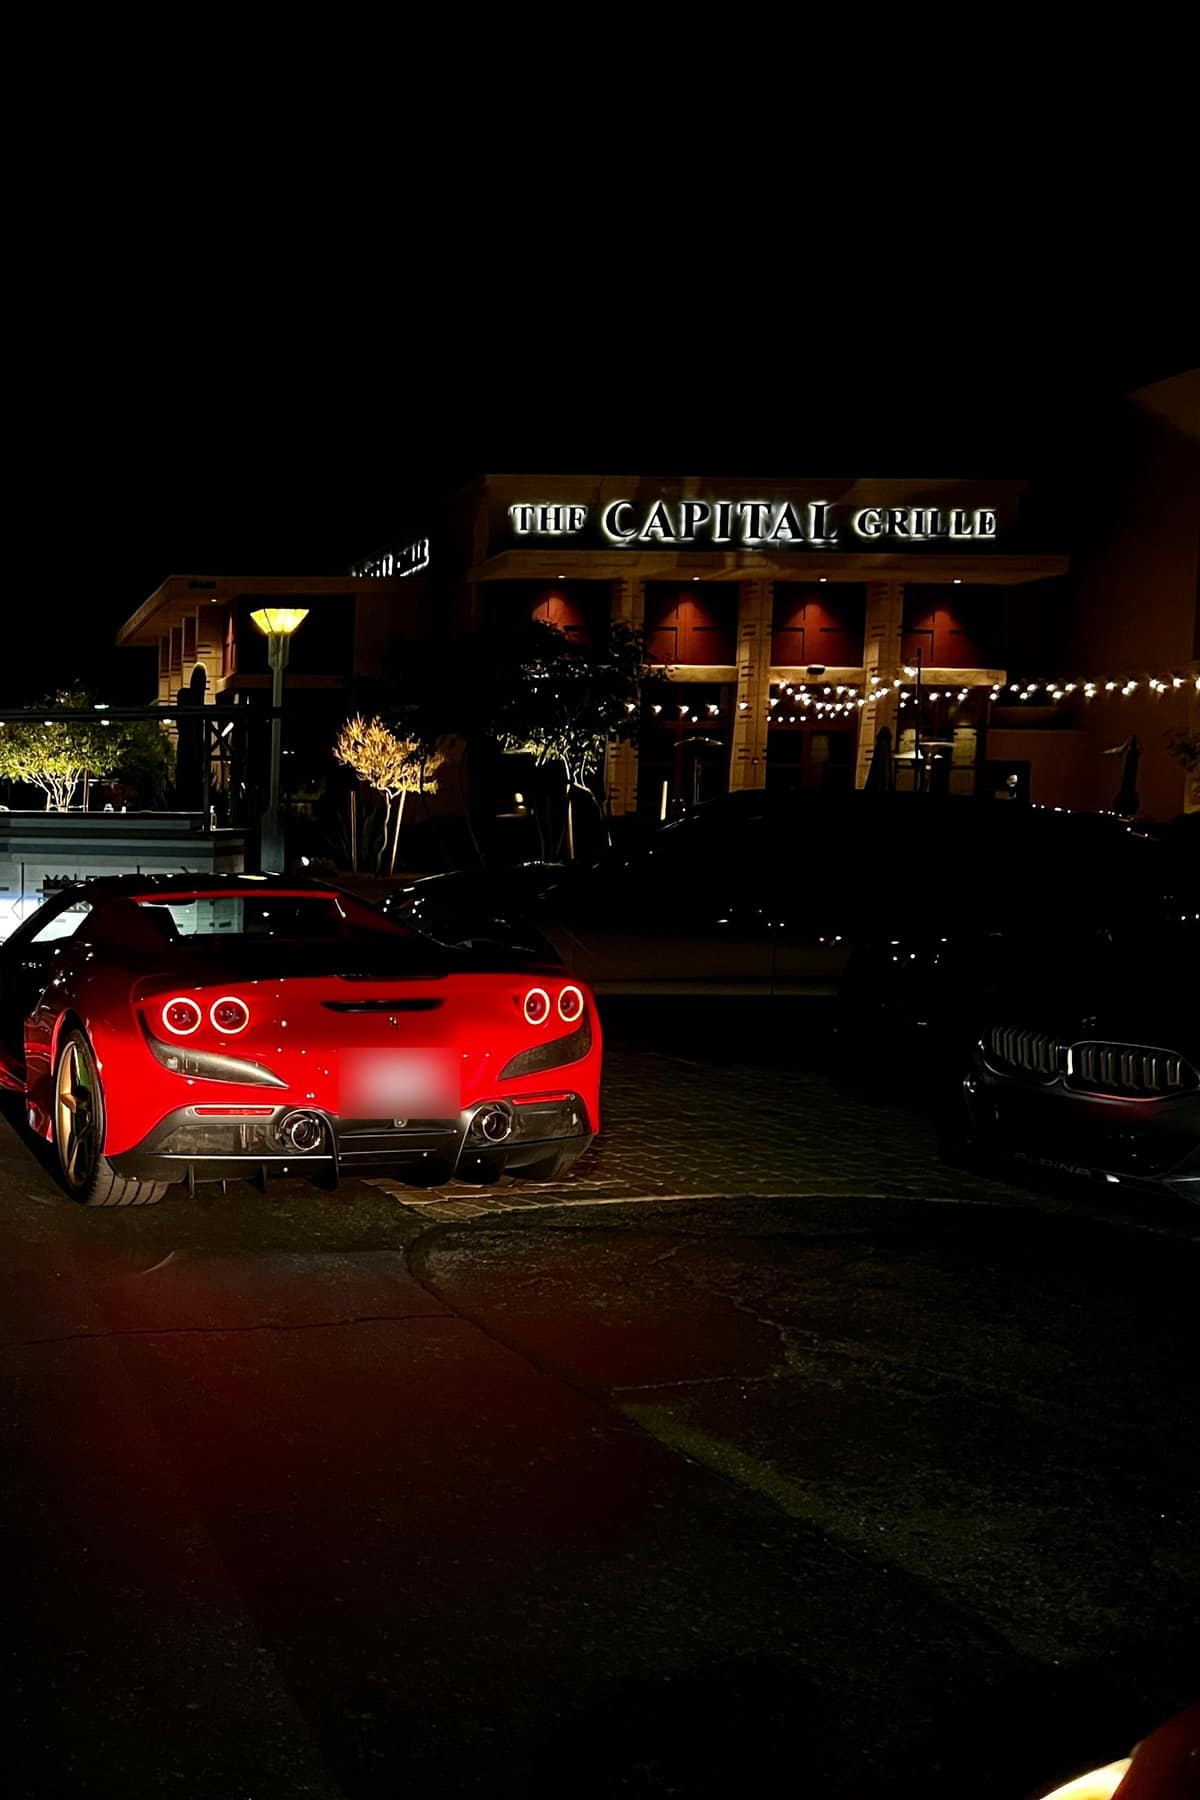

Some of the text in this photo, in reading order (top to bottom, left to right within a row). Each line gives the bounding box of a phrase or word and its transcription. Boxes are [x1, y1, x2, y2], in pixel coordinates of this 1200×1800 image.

[510, 501, 998, 541] THE CAPITAL GRILLE
